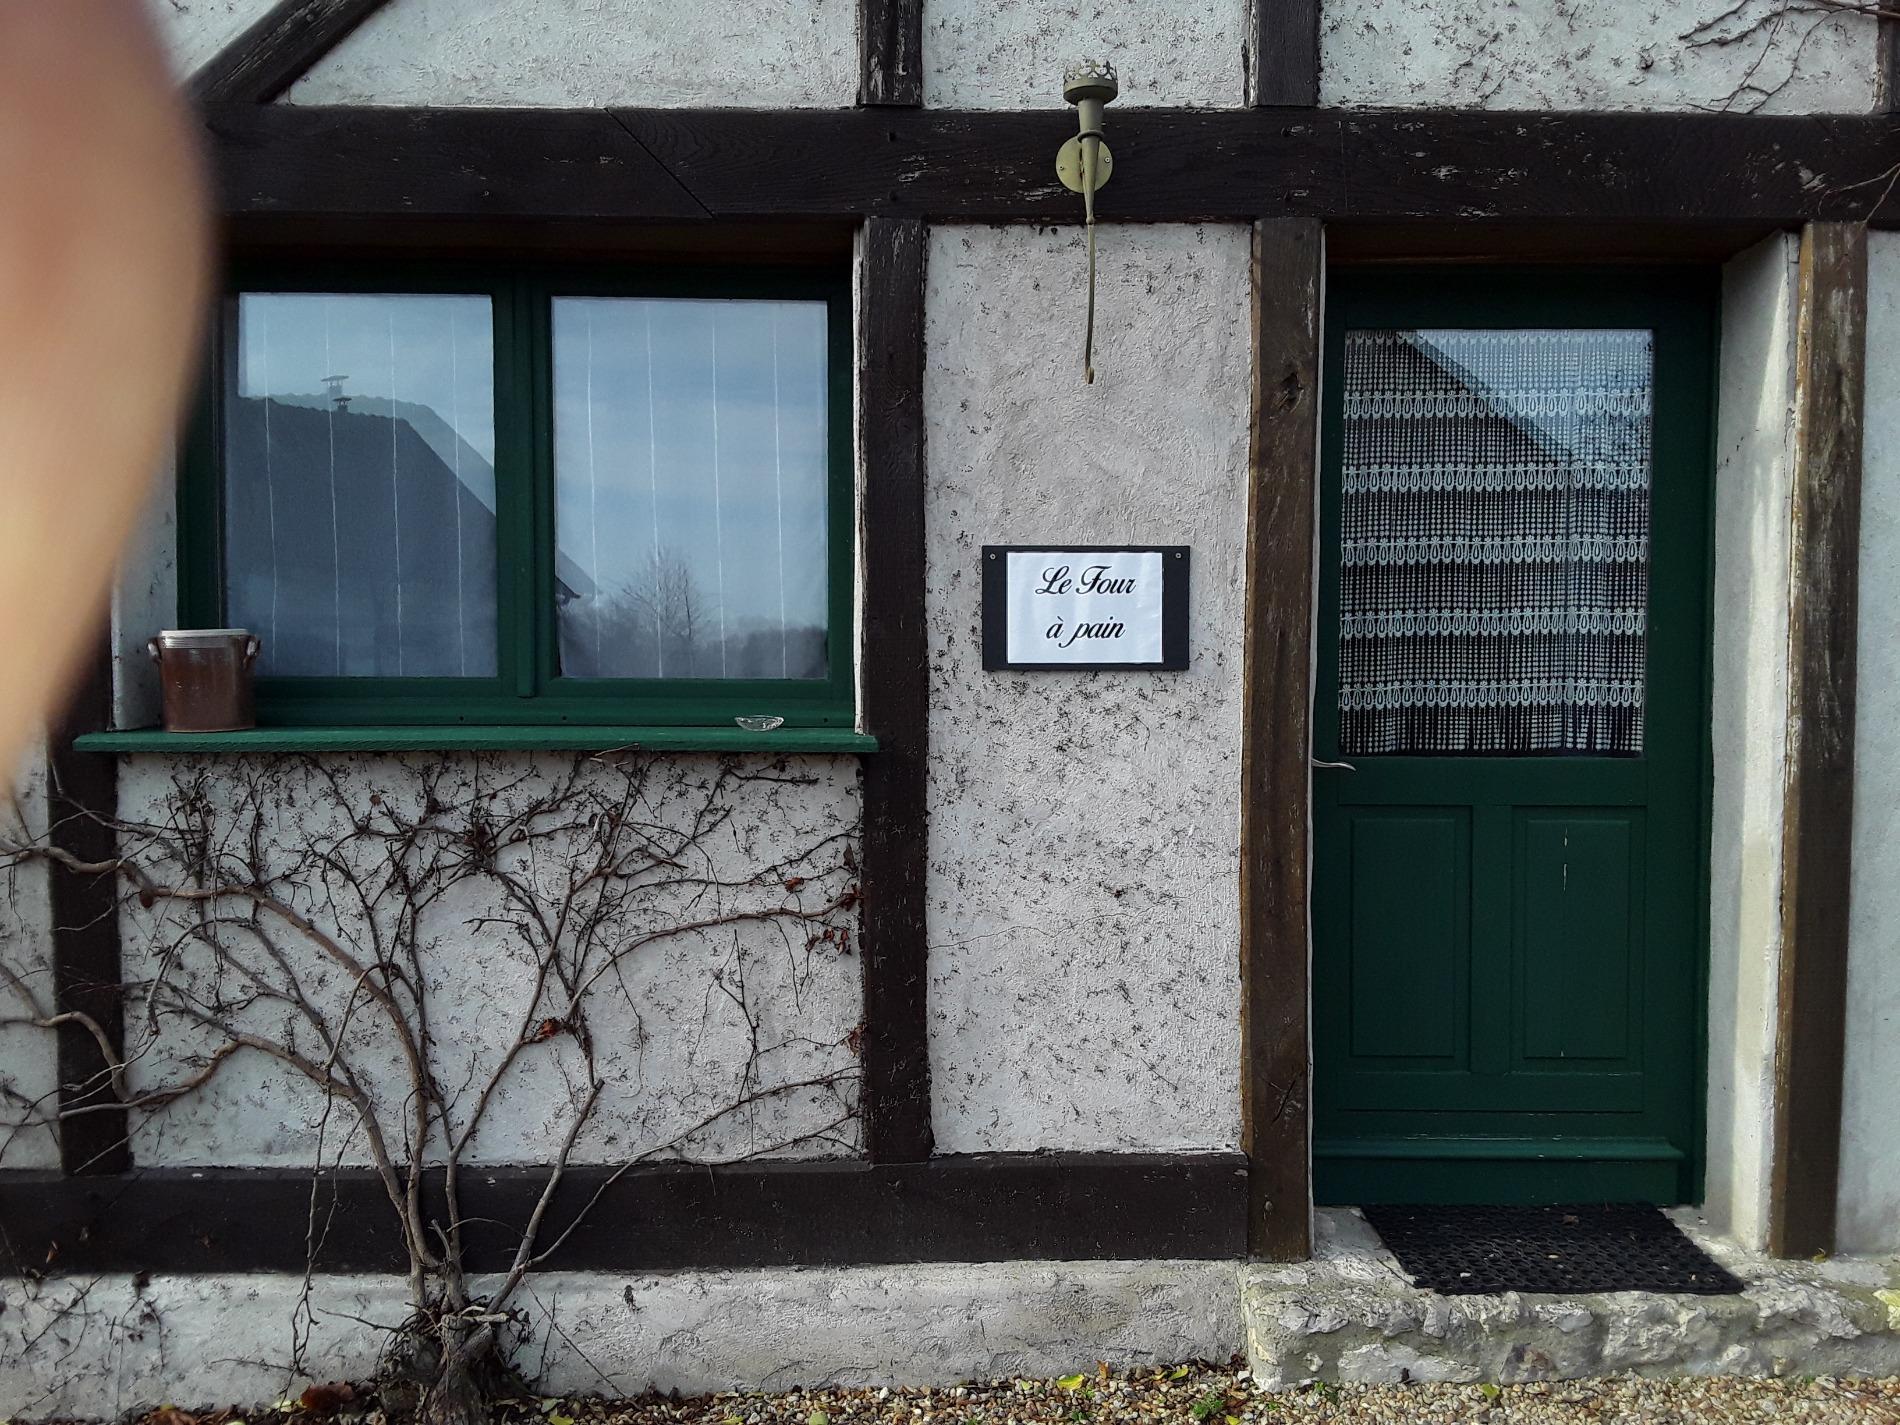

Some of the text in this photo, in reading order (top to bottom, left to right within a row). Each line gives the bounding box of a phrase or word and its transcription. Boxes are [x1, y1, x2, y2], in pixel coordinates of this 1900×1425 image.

[1035, 565, 1137, 594] Le Four
[1046, 615, 1126, 648] à pain
